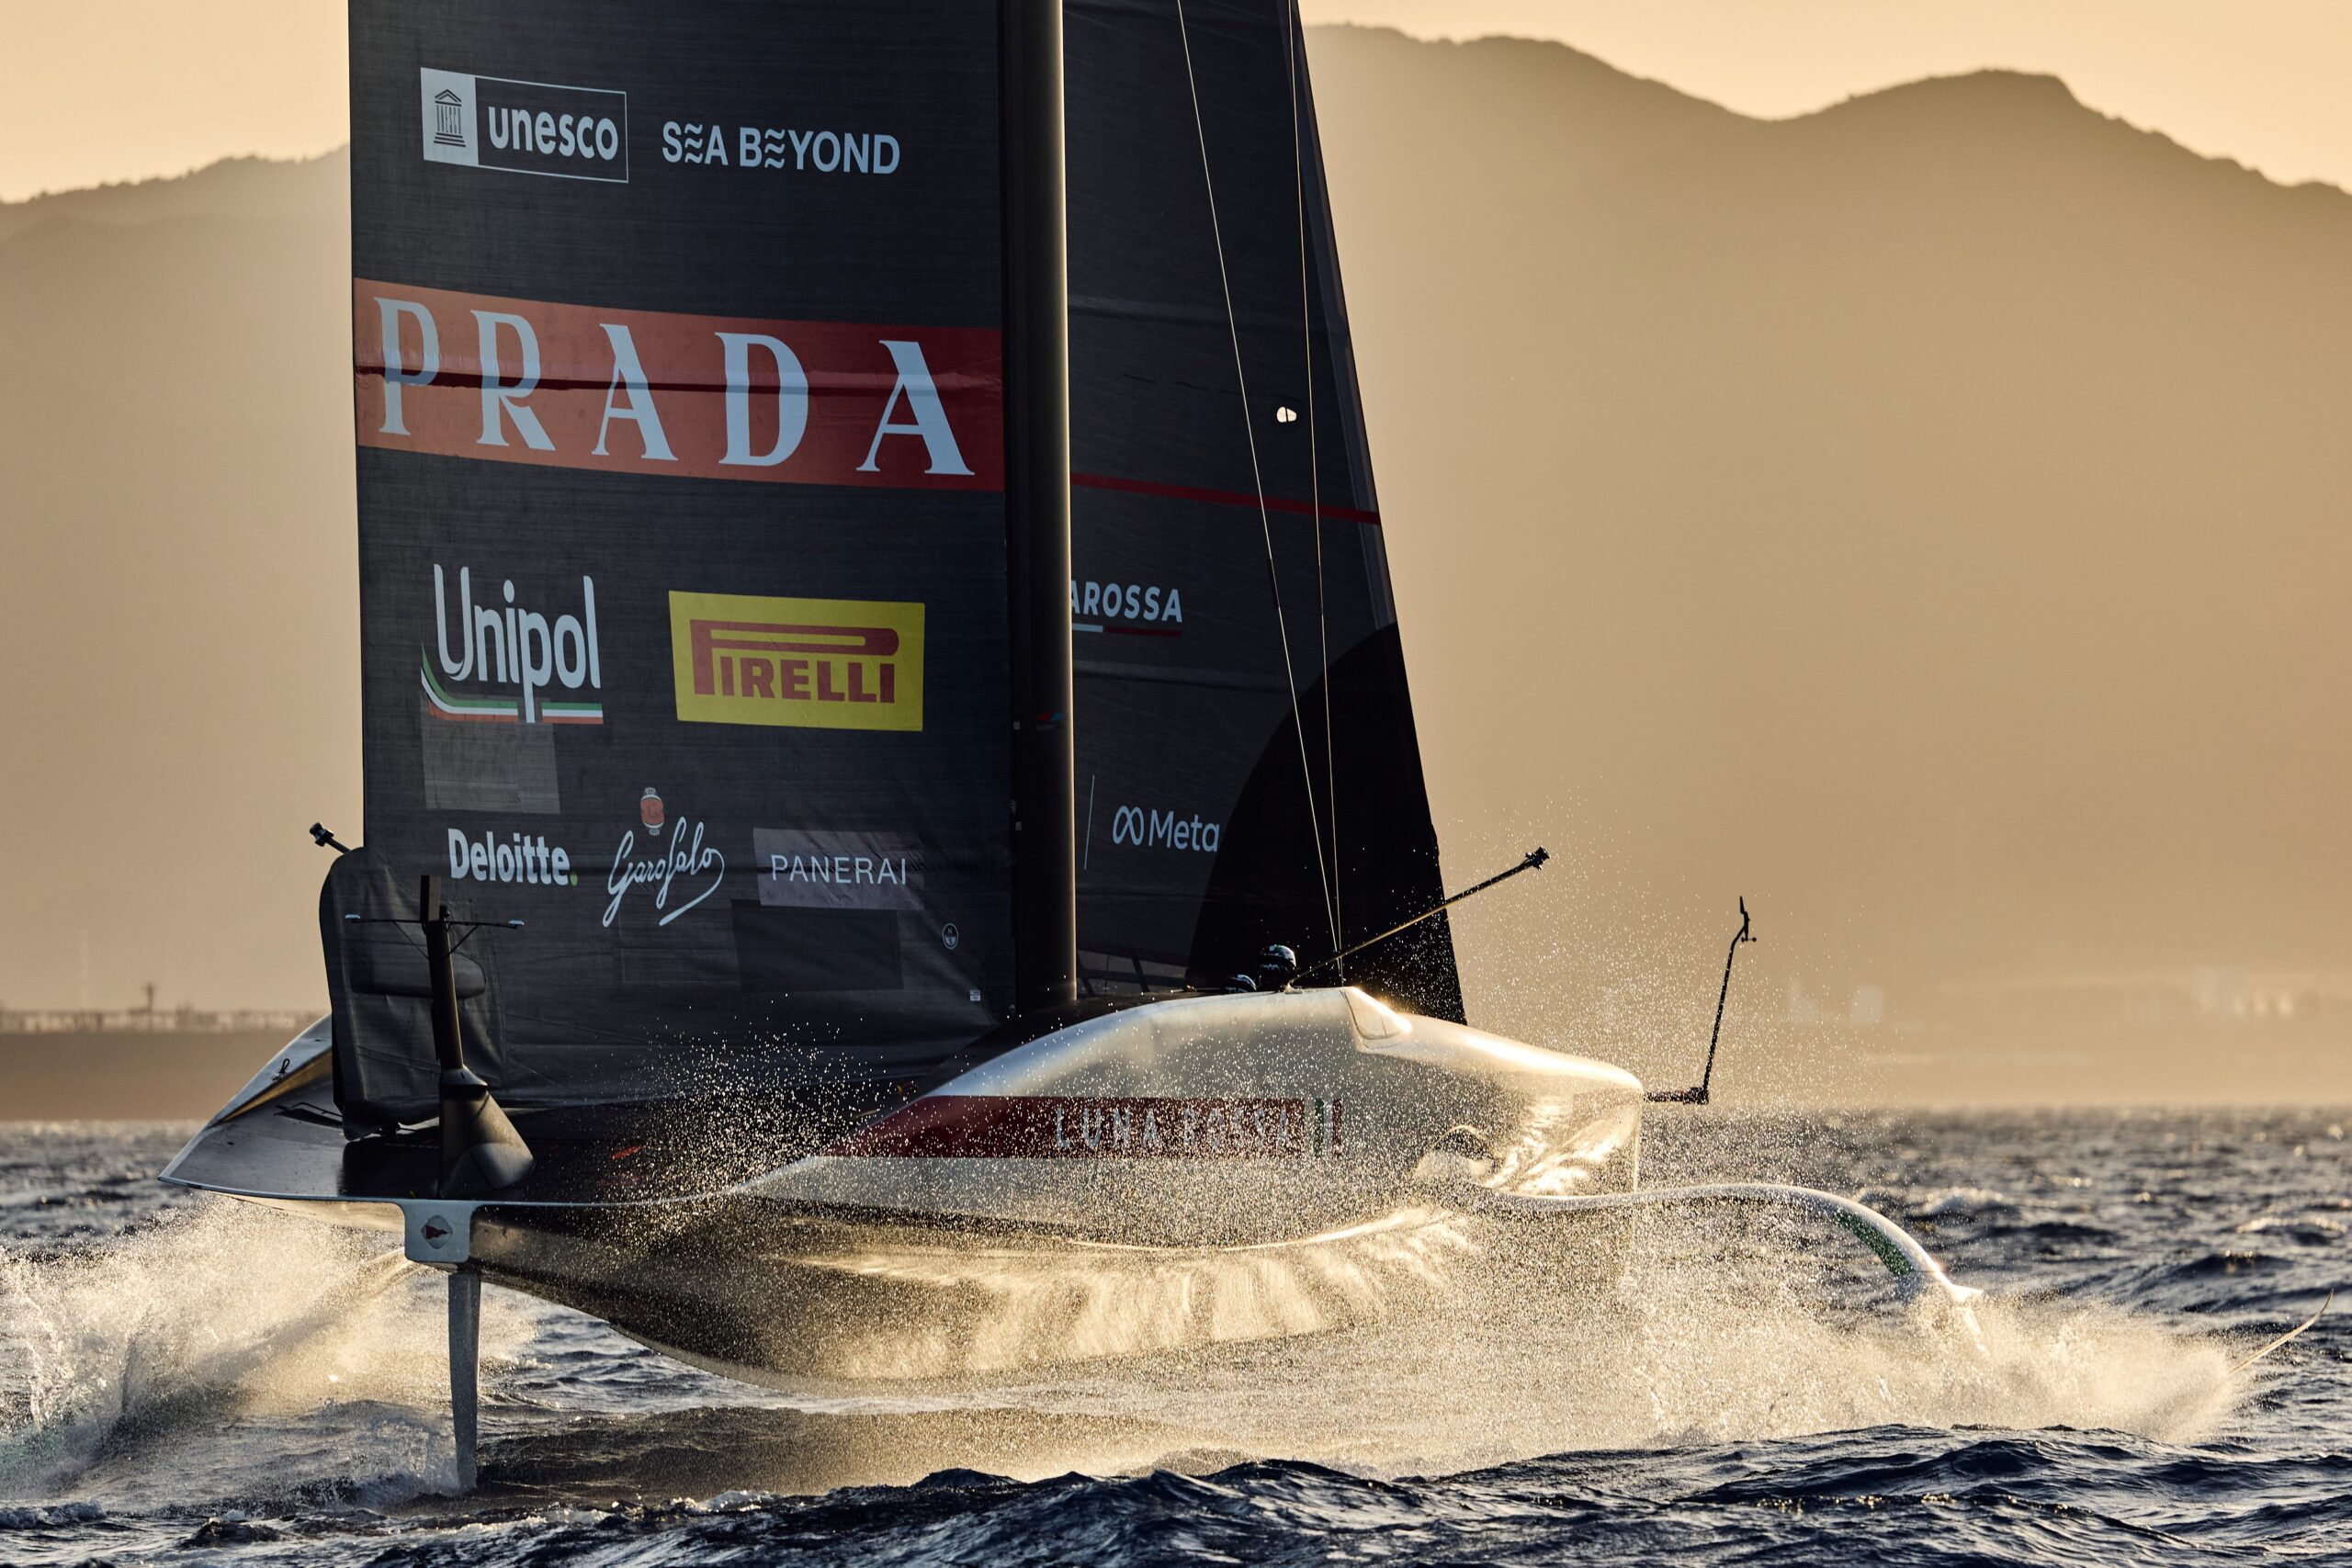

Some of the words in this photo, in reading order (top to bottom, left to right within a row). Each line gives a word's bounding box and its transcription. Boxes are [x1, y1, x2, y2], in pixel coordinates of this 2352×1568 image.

[489, 107, 618, 161] unesco
[374, 297, 975, 476] PRADA
[434, 563, 601, 724] Unipol
[690, 619, 899, 704] PIRELLI
[447, 828, 578, 886] Deloitte.
[1148, 808, 1220, 852] Meta
[602, 816, 725, 928] Garofalo
[771, 854, 906, 886] PANERAI
[1056, 1107, 1159, 1149] LUNA
